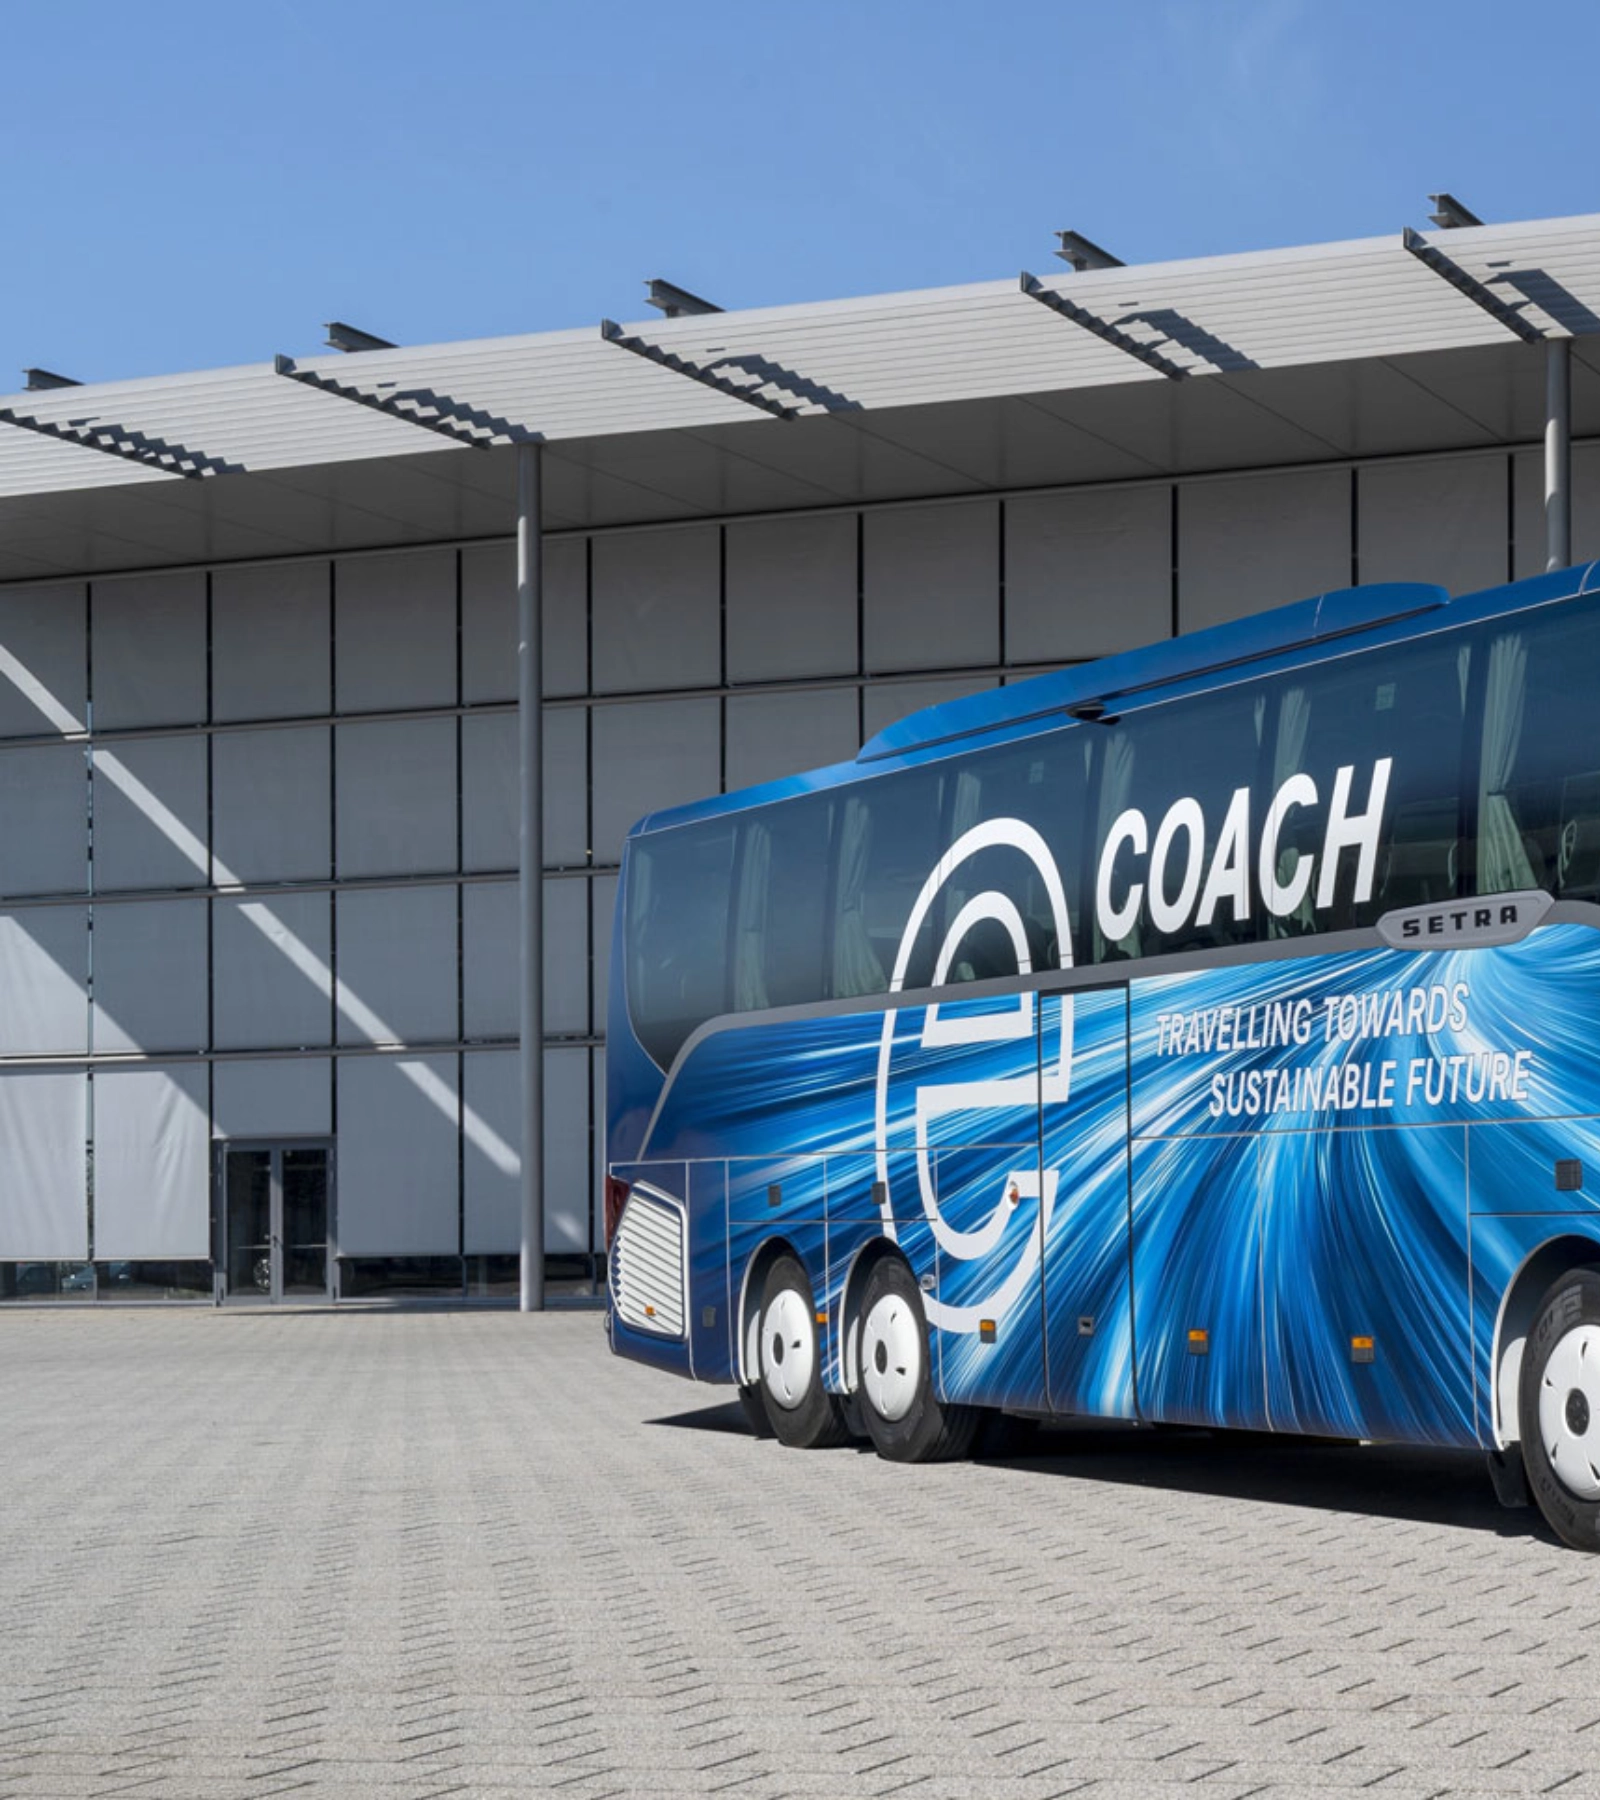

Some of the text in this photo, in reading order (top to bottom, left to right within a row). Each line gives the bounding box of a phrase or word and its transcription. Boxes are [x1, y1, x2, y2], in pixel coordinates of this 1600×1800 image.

[1096, 757, 1393, 941] COACH
[1403, 905, 1518, 938] SETRA
[1156, 983, 1469, 1057] TRAVELLING TOWARDS
[1209, 1051, 1533, 1118] SUSTAINABLE FUTURE
